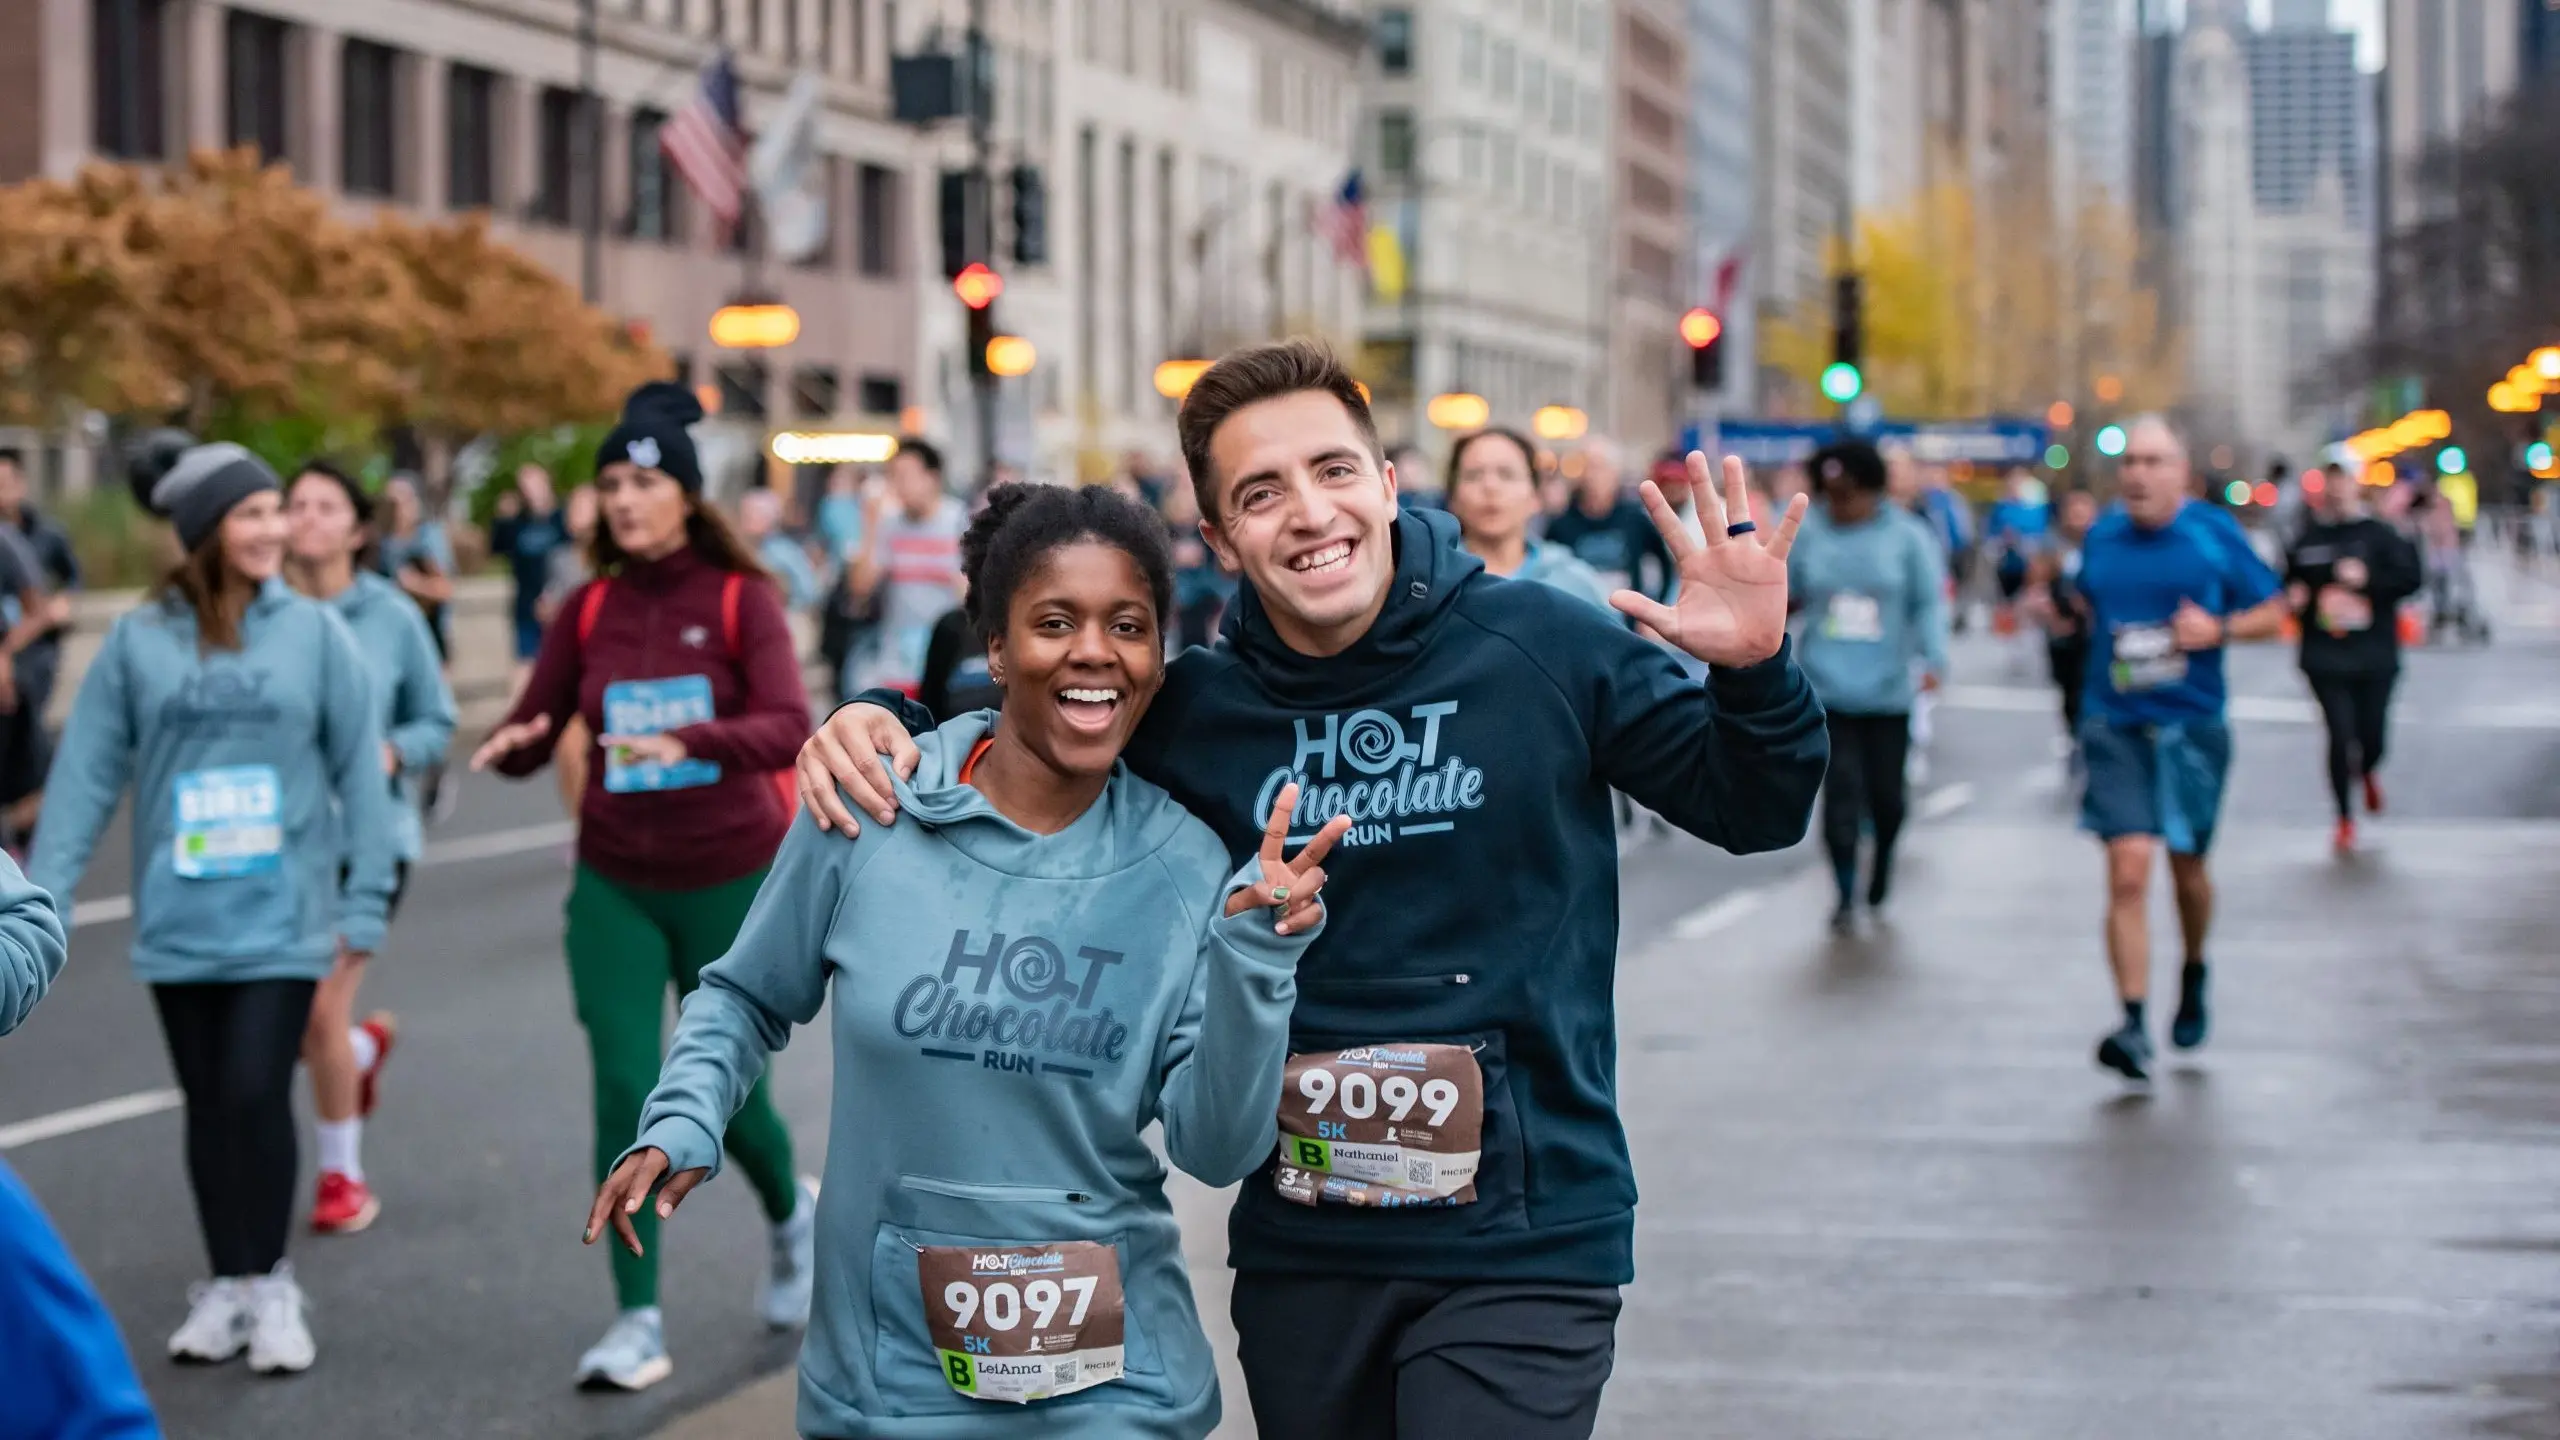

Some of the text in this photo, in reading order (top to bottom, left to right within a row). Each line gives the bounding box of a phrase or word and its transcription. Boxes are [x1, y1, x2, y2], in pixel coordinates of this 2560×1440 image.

[1293, 700, 1459, 779] HOT
[1253, 755, 1485, 833] Chocolate
[1343, 822, 1393, 847] RUN
[941, 929, 1124, 1010] HOT
[892, 974, 1128, 1063] Chocolate
[983, 1050, 1034, 1075] RUN
[1372, 1061, 1389, 1070] RUN
[1299, 1068, 1459, 1127] 9099
[1317, 1121, 1347, 1139] 5K
[1299, 1142, 1399, 1166] B Nathaniel
[1278, 1183, 1312, 1197] DONATION
[972, 1254, 1011, 1270] HOT
[1010, 1268, 1027, 1277] RUN
[944, 1276, 1099, 1331] 9097
[963, 1335, 992, 1354] 5K
[948, 1355, 1042, 1387] B LeiAnna
